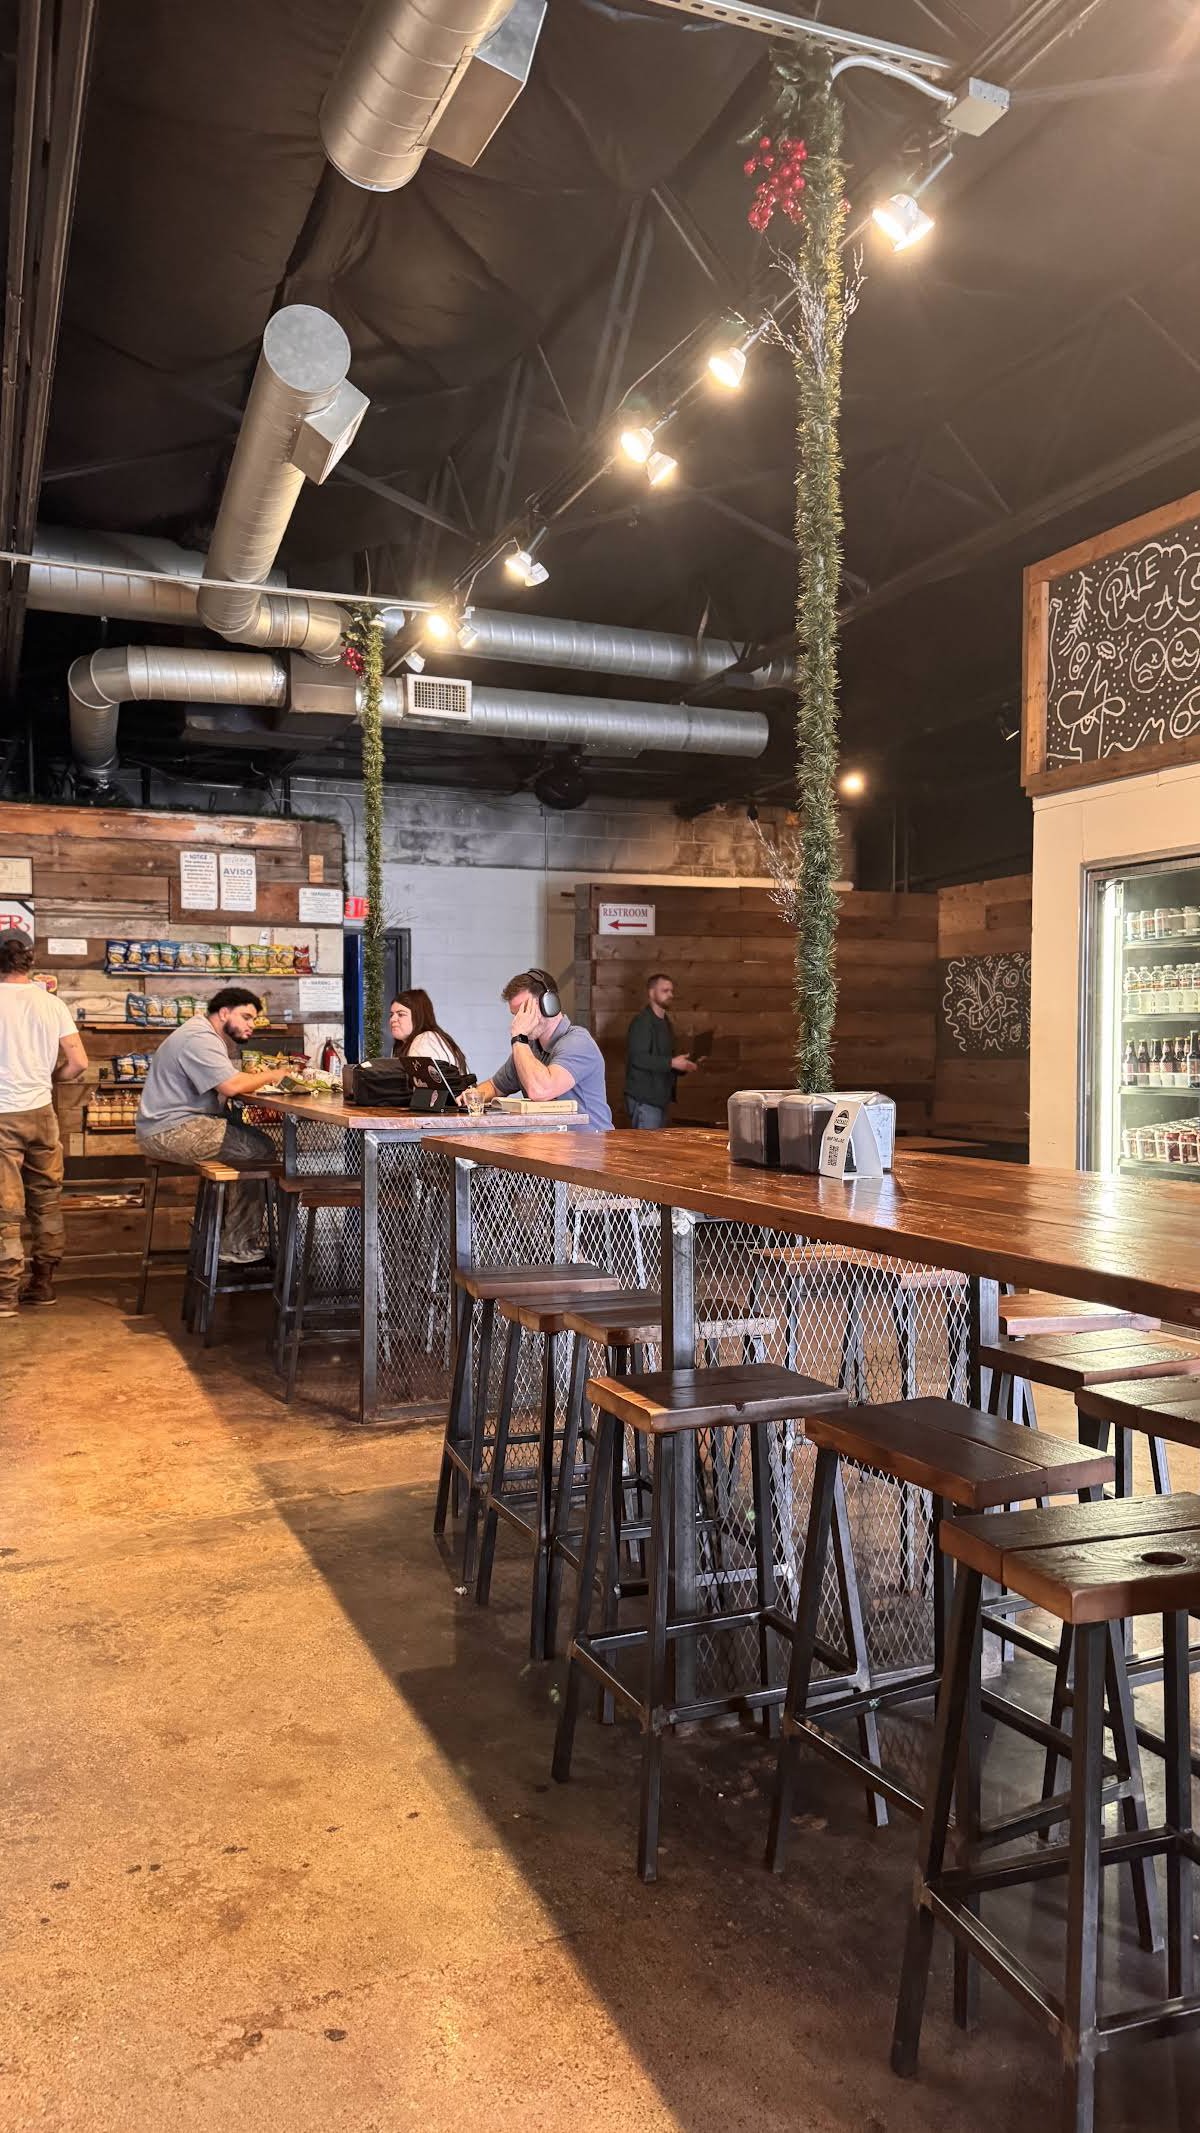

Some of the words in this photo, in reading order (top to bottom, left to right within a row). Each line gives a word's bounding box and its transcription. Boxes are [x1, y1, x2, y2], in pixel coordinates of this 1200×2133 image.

[1106, 554, 1160, 619] PALE
[223, 867, 253, 876] AVISO
[602, 907, 648, 917] RESTROOM
[972, 995, 1003, 1026] LAGER
